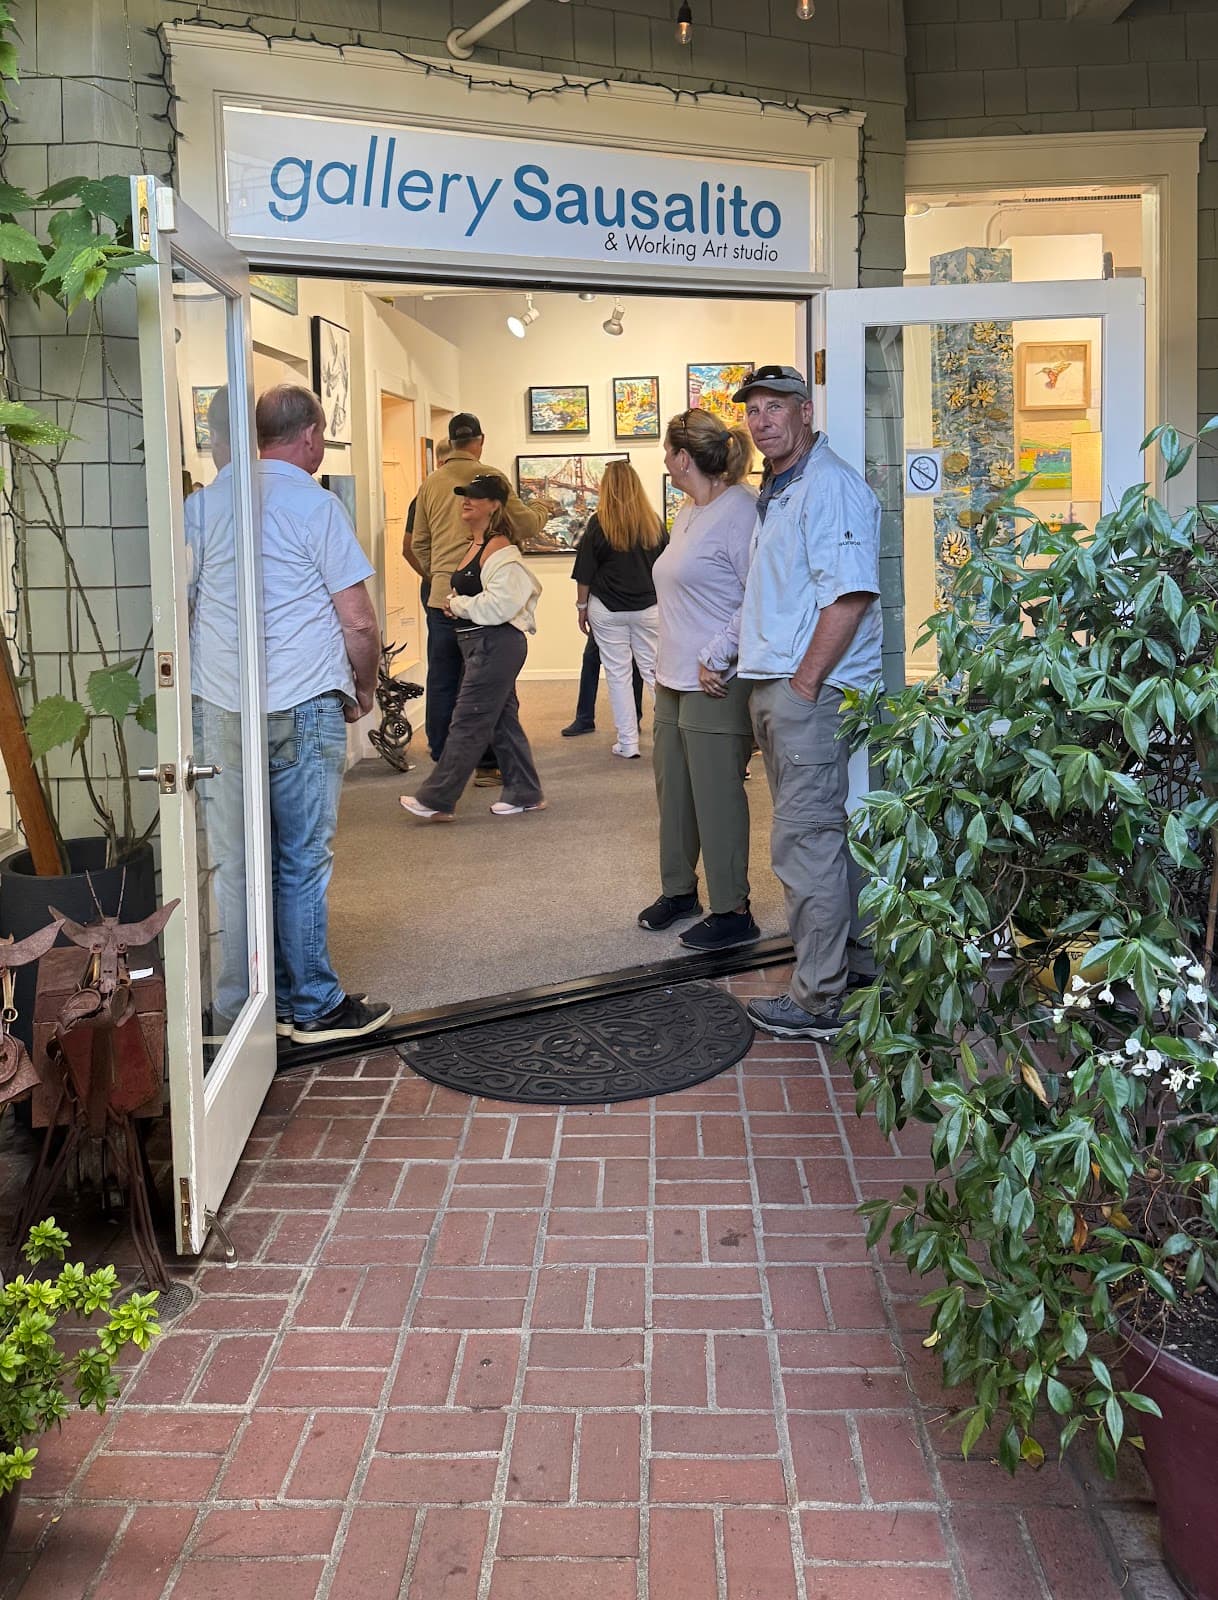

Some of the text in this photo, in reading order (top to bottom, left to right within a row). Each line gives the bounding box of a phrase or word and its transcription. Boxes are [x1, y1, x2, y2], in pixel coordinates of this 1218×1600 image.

[268, 136, 781, 240] gallery Sausalito
[604, 231, 778, 262] & Working Art studio
